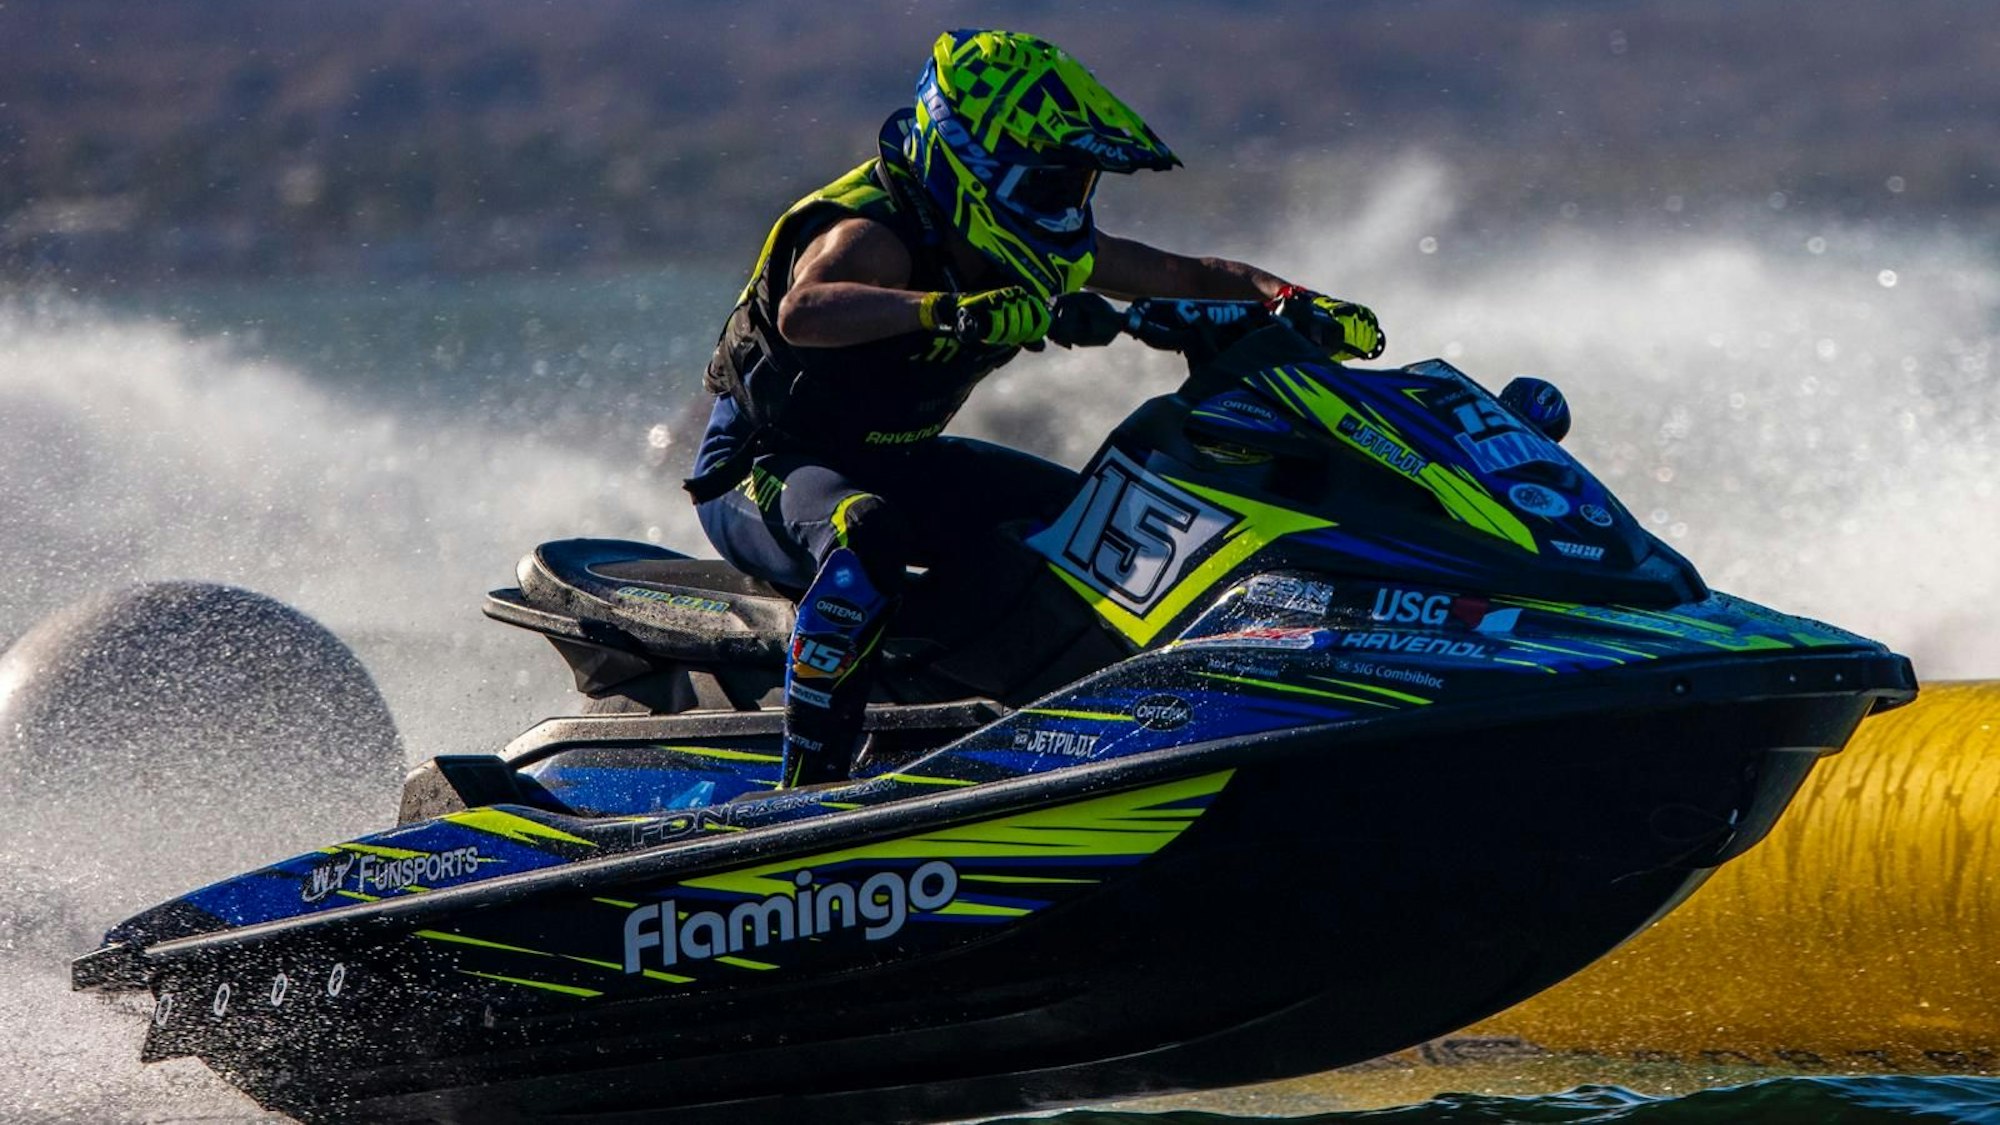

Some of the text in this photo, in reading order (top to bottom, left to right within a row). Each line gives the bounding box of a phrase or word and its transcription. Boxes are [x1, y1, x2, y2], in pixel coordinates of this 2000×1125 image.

[1352, 426, 1426, 475] JETPILOT
[1062, 457, 1200, 604] 15
[816, 600, 863, 623] ORTEMA
[1371, 587, 1451, 625] USG
[800, 638, 845, 673] 15
[1341, 632, 1487, 659] RAVENOL
[1351, 662, 1445, 690] SIG Combibloc
[1135, 703, 1188, 721] ORTEMA
[1026, 730, 1100, 759] JETPILOT
[631, 777, 898, 846] FDN RACING TEAM
[358, 846, 479, 894] FUNSPORTS
[624, 861, 959, 975] Flamingo
